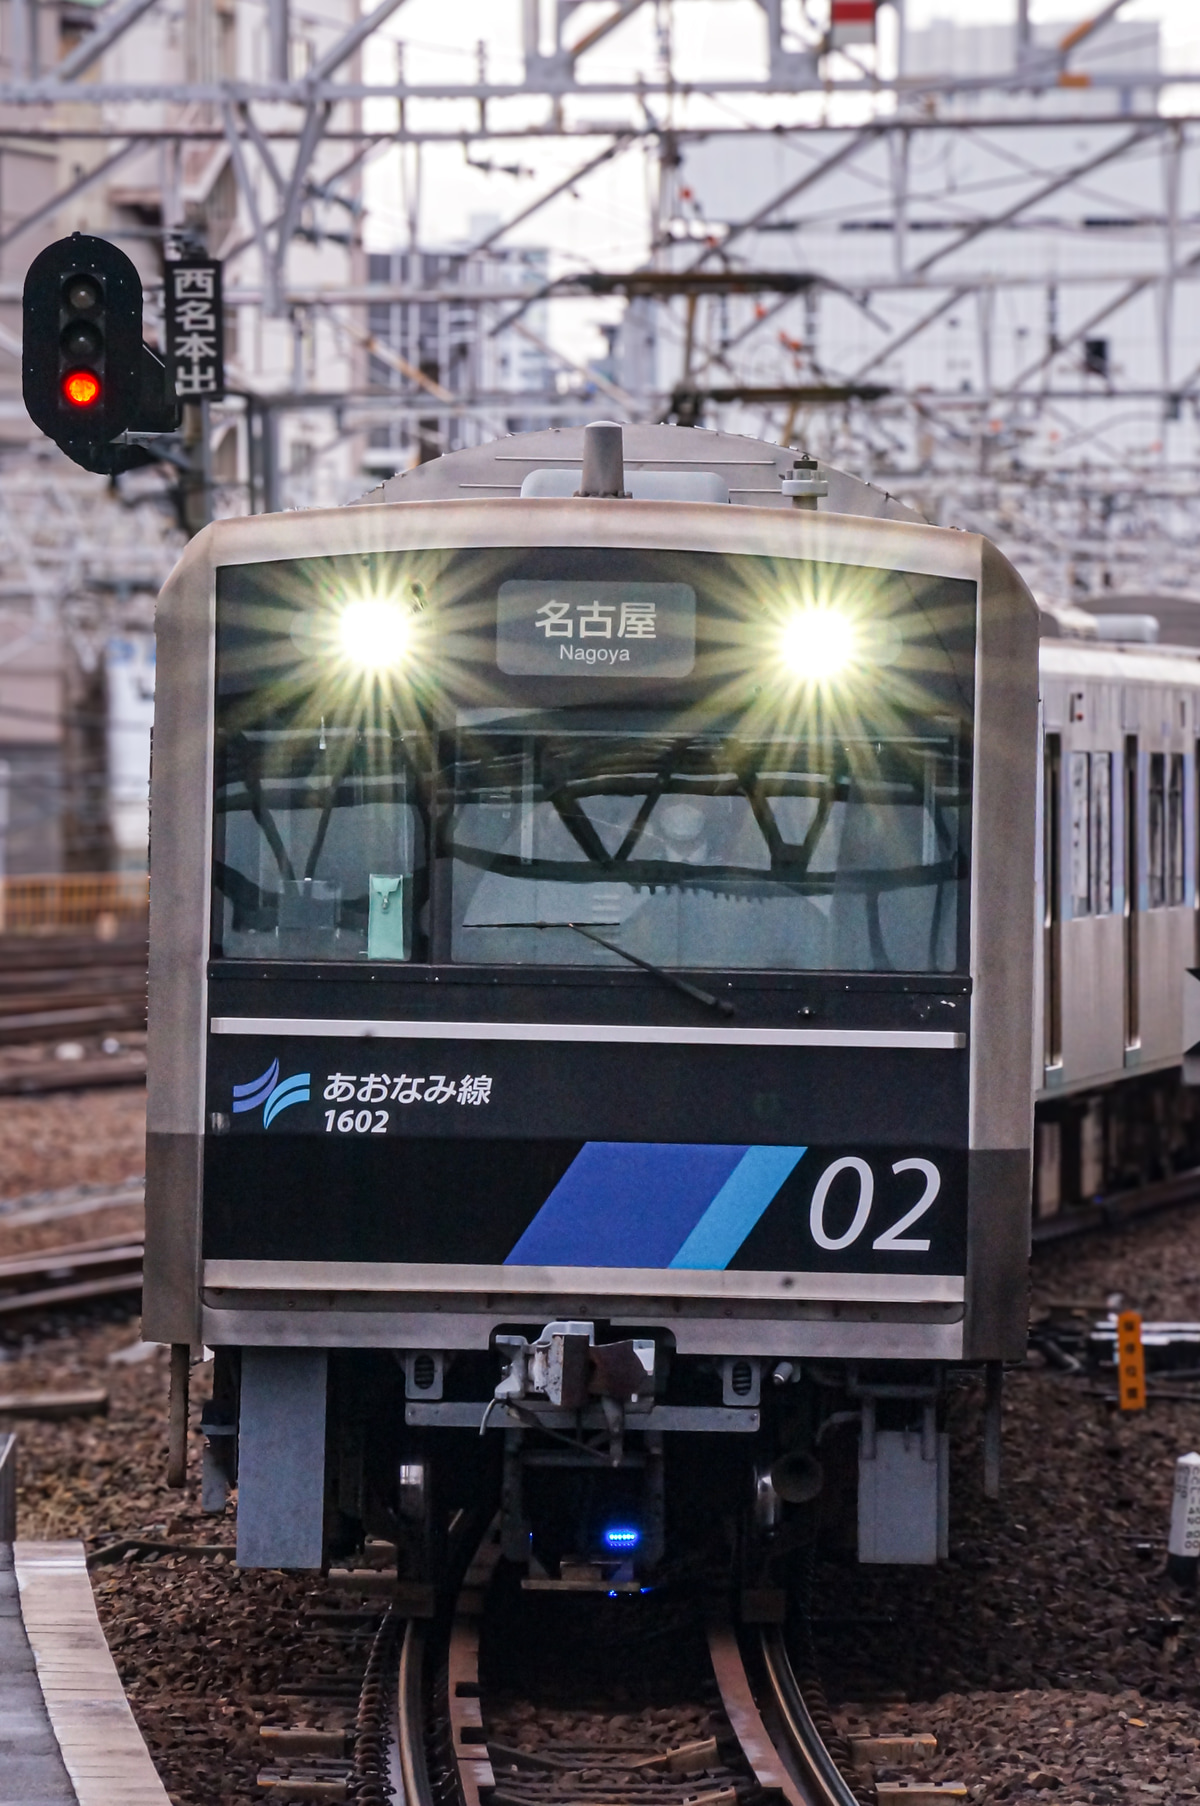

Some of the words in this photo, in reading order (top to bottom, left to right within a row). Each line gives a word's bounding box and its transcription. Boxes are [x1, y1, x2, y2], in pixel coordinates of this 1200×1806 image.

[173, 267, 217, 397] 西名本出
[534, 599, 657, 639] 名古屋
[559, 644, 631, 665] Nagoya
[322, 1072, 493, 1106] あおなみ線
[323, 1109, 389, 1134] 1602
[809, 1156, 942, 1252] 02
